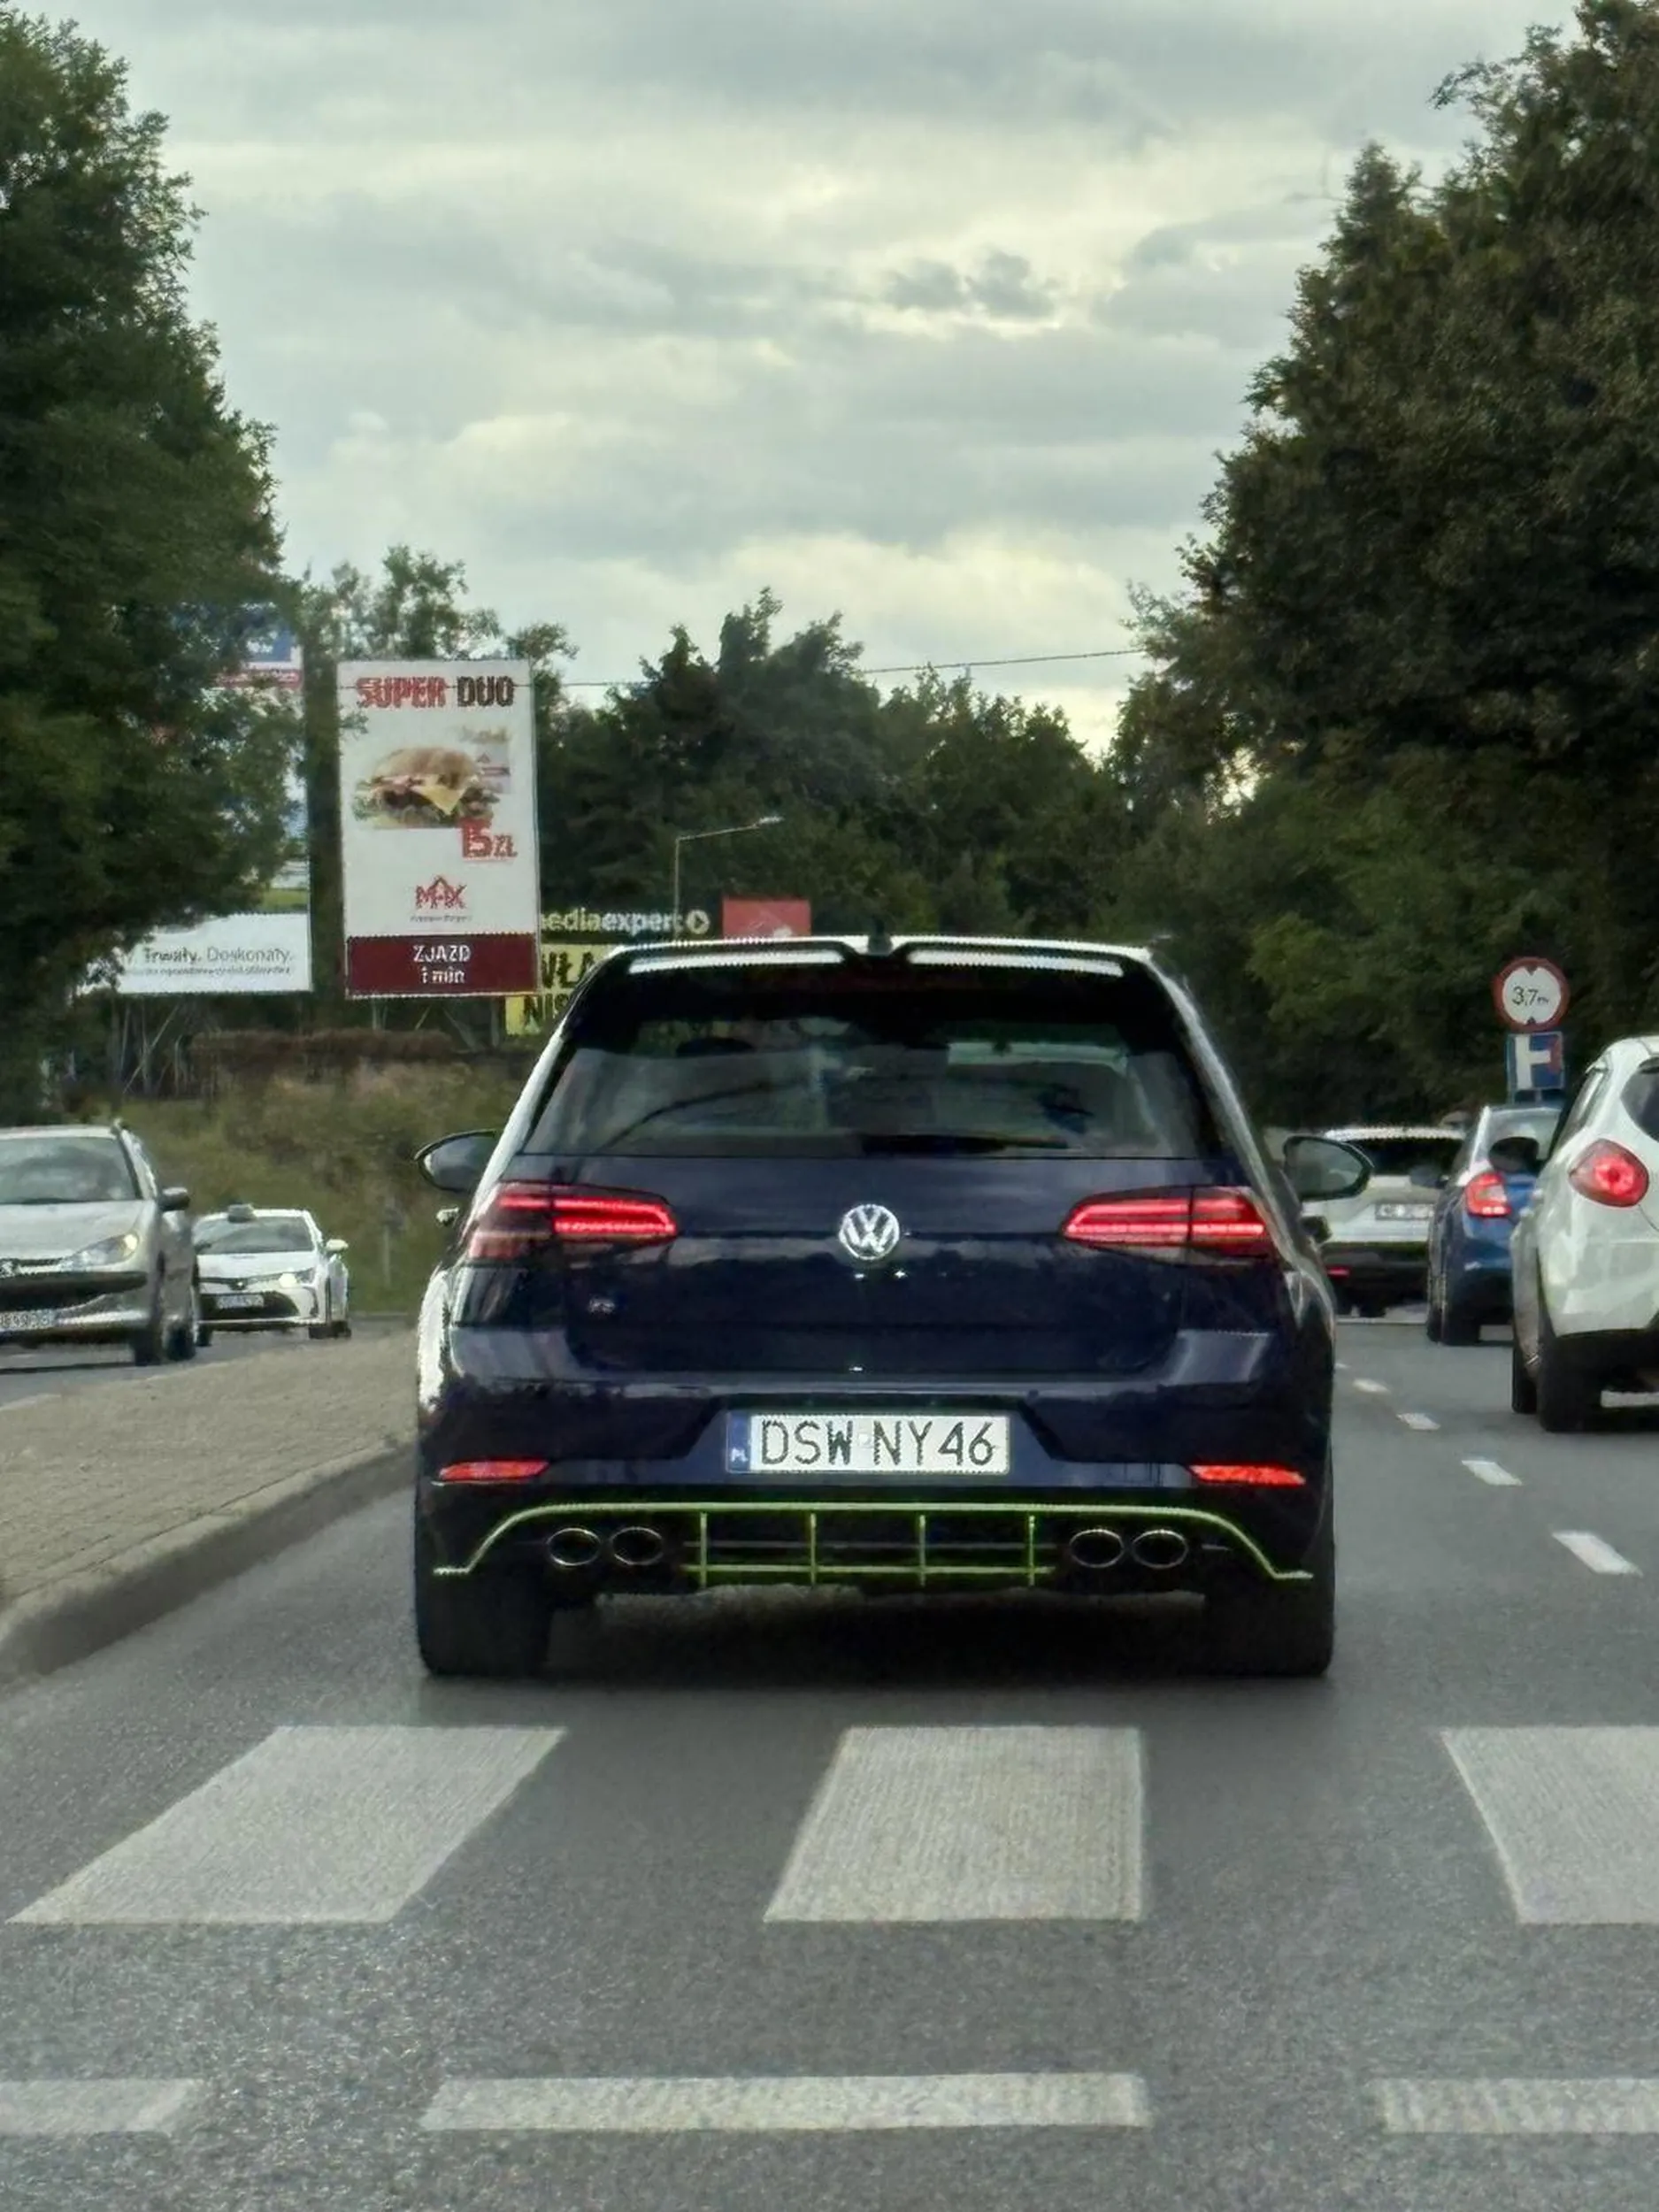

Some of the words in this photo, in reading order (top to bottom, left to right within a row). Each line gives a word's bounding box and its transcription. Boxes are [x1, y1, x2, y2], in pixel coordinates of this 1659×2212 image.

[356, 675, 446, 708] SUPER
[457, 675, 514, 707] DUO
[415, 875, 467, 909] MAX
[541, 907, 683, 936] ediaexpert
[412, 944, 472, 963] ZJAZD
[432, 965, 465, 984] min
[761, 1419, 854, 1466] DSW
[873, 1419, 993, 1467] NY46
